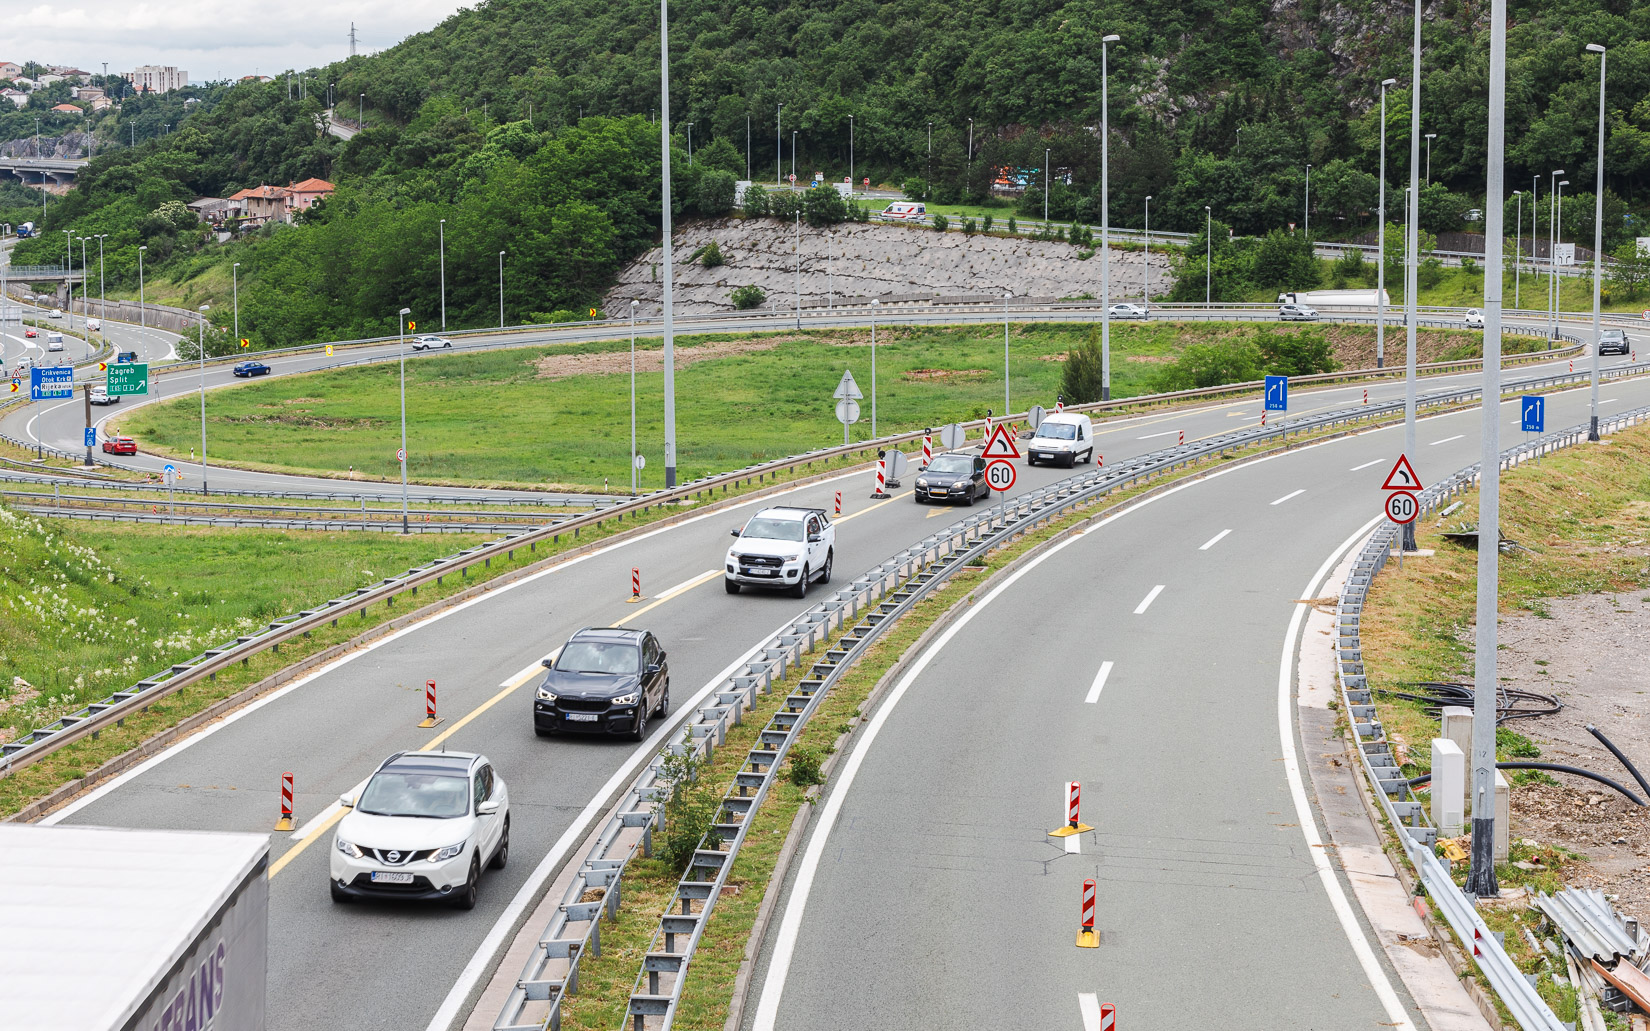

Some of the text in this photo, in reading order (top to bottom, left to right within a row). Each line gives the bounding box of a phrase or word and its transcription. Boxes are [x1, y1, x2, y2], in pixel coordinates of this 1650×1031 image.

[110, 367, 134, 376] Zagreb
[110, 376, 127, 384] Split
[991, 467, 1010, 483] 60
[1392, 499, 1412, 516] 60
[154, 939, 226, 1031] TRANS
